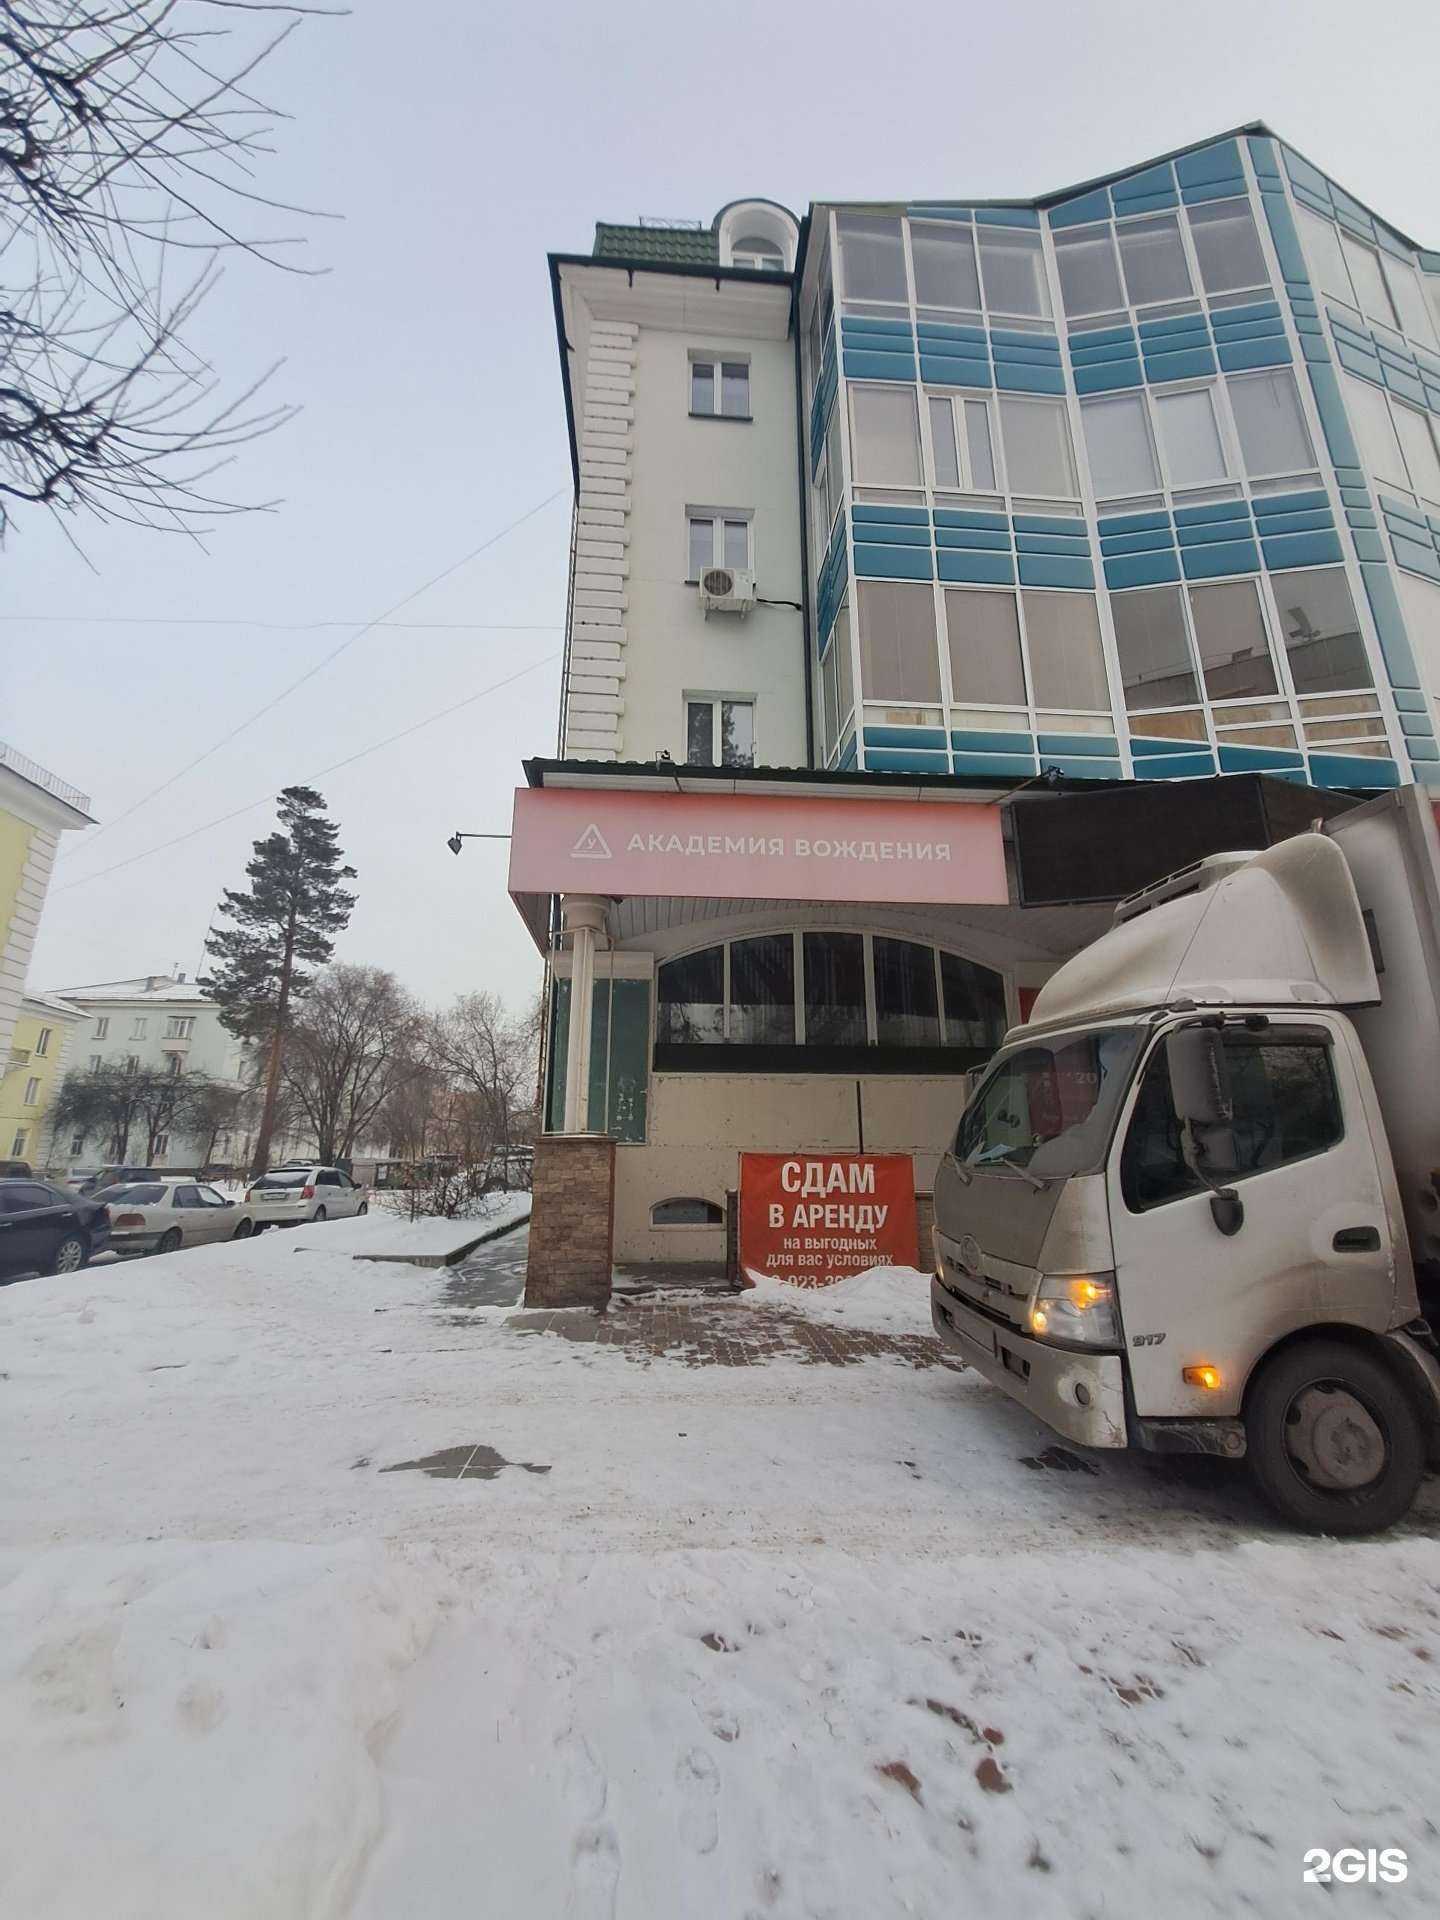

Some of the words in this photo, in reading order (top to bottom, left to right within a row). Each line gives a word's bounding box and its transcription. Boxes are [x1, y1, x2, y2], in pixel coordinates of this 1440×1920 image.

[627, 832, 784, 856] АКАДЕМИЯ
[795, 838, 951, 862] ВОЖДЕНИЯ
[781, 1161, 876, 1198] СДАМ
[768, 1203, 785, 1228] В
[792, 1204, 889, 1233] АРЕНДУ
[783, 1238, 800, 1250] на
[804, 1238, 877, 1251] выгодных
[766, 1254, 794, 1268] для
[798, 1255, 823, 1267] вас
[827, 1255, 893, 1270] условиях
